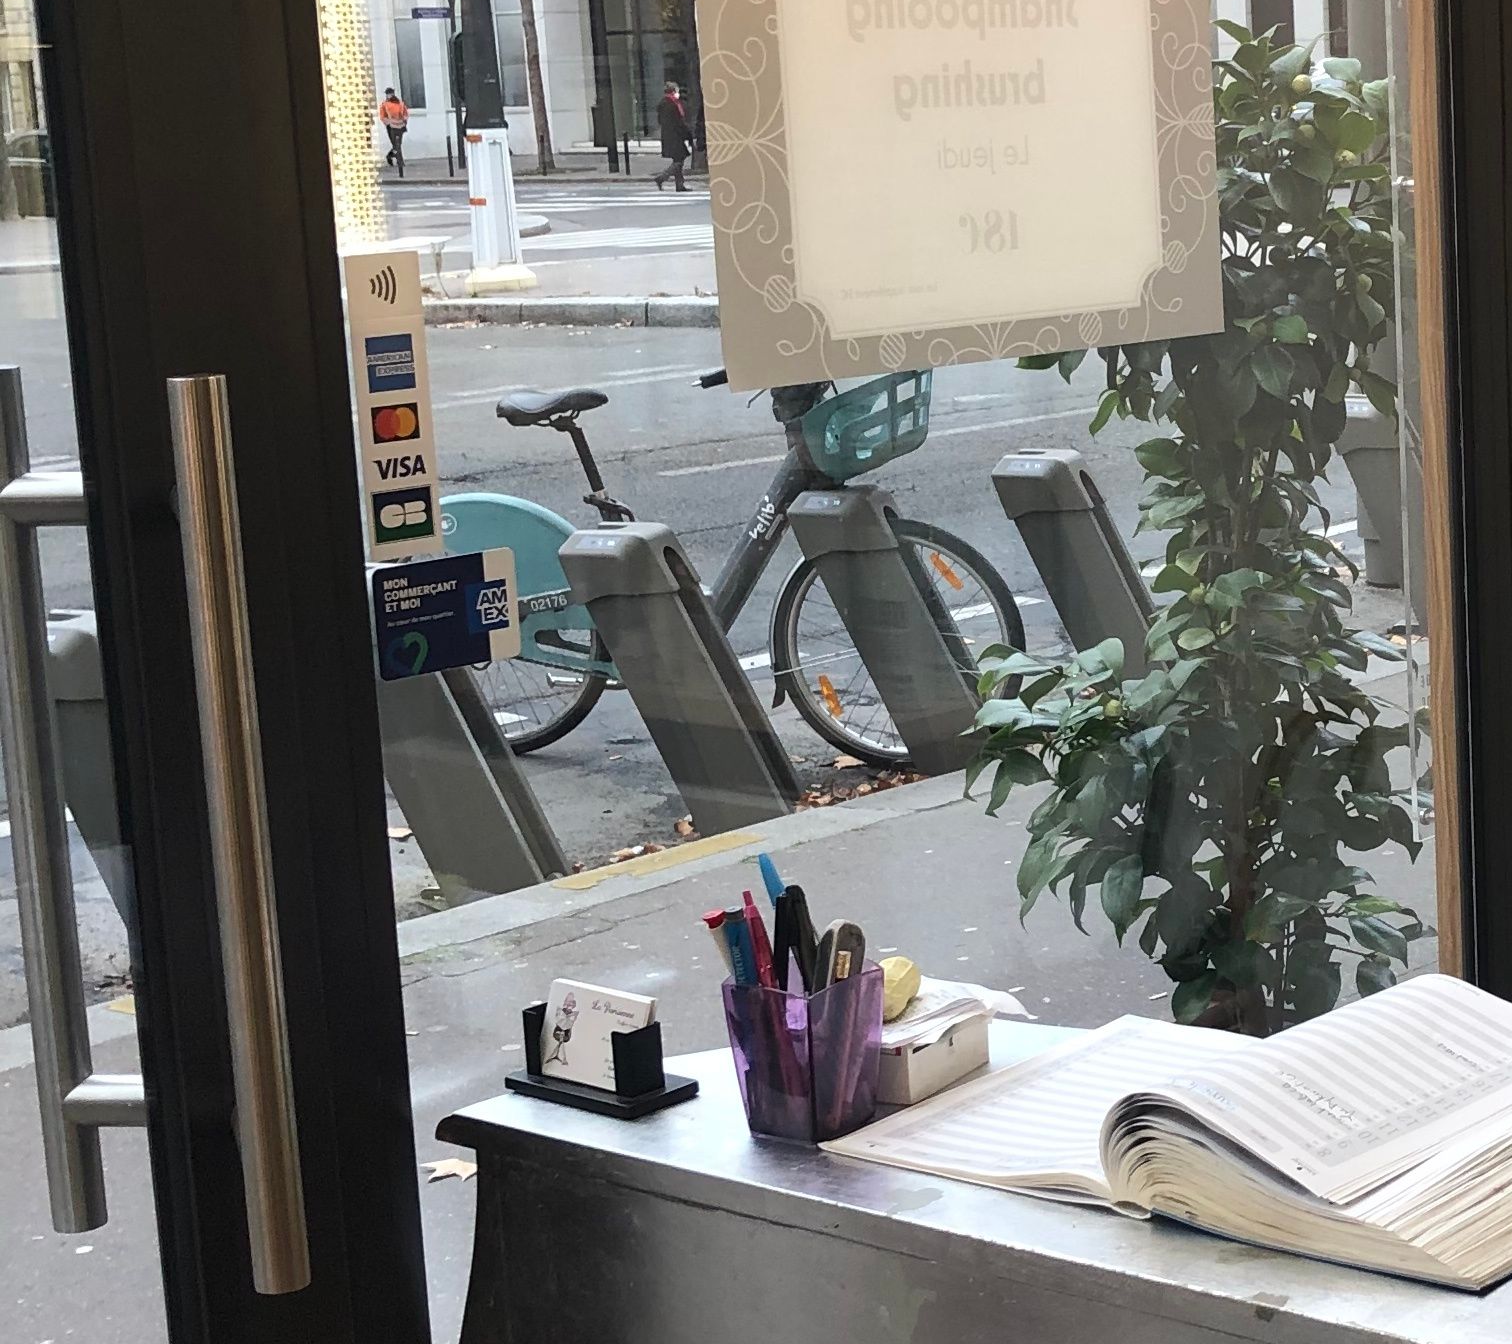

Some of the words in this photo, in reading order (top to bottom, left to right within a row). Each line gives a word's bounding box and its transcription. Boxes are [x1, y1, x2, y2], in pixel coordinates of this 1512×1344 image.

[373, 454, 426, 480] VISA
[383, 578, 408, 590] MON
[384, 580, 458, 602] COMMERÇANT
[386, 602, 398, 613] ET
[400, 598, 421, 610] MOI
[530, 595, 568, 612] 02176
